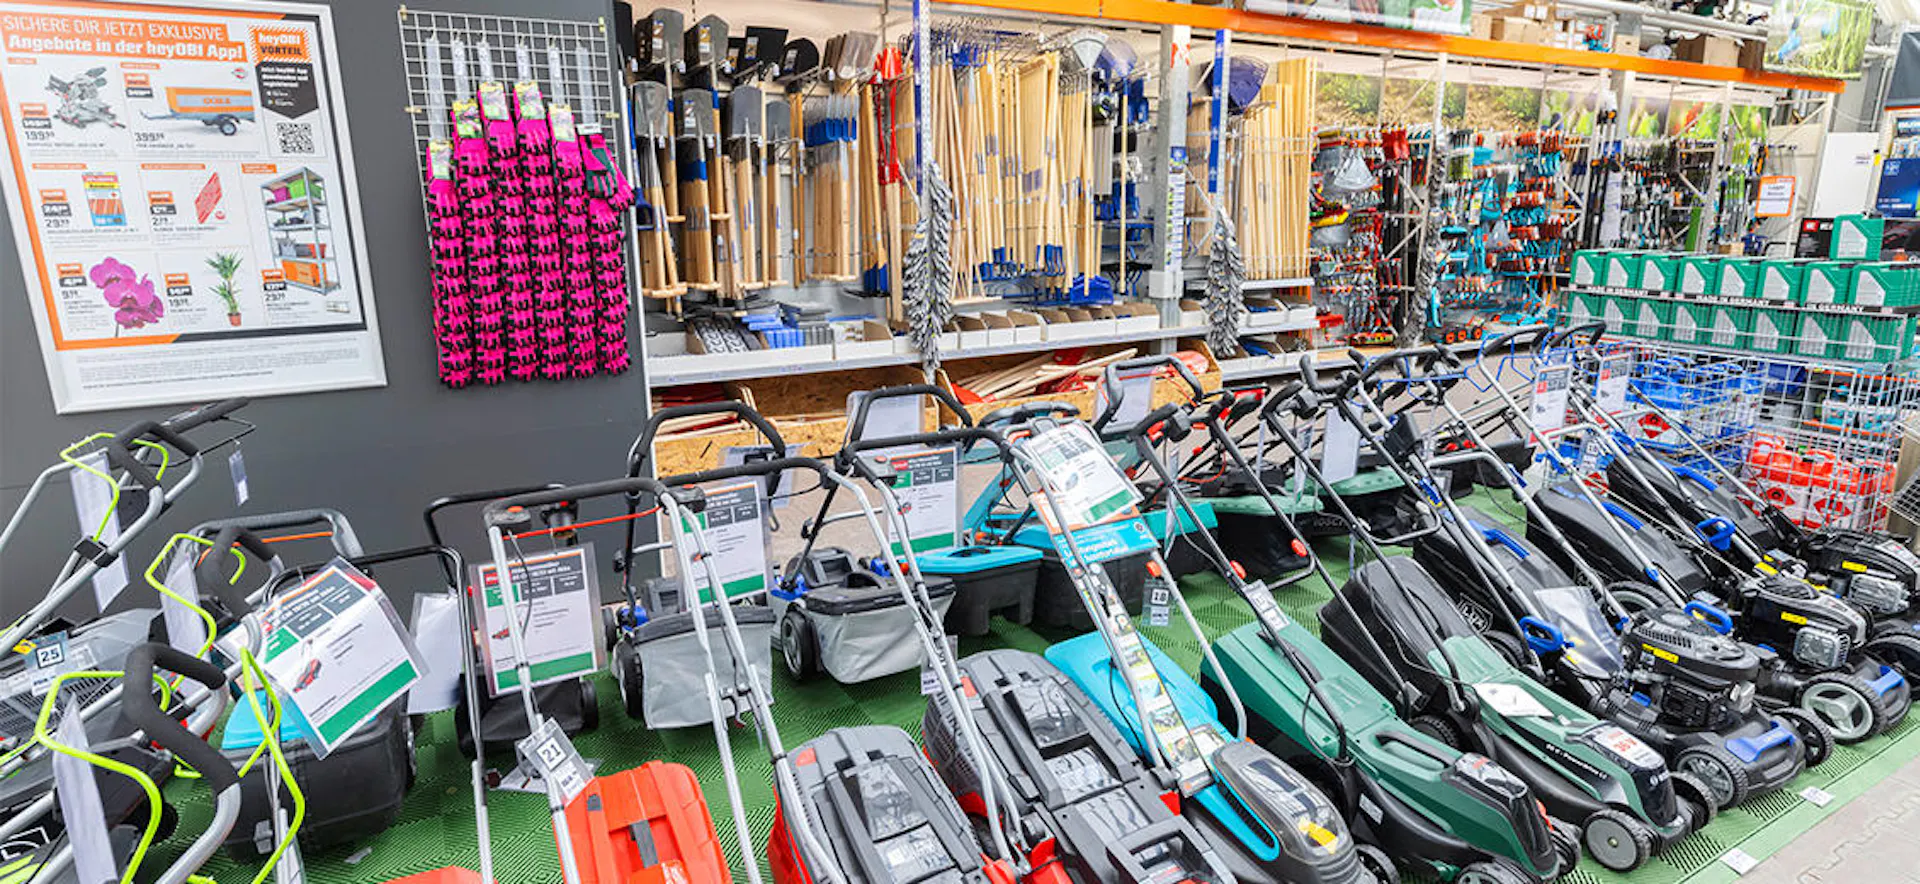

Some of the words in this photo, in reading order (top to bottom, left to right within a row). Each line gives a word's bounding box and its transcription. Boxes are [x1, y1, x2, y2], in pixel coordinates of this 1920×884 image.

[3, 15, 70, 33] SICHERE
[73, 19, 100, 34] DIR
[104, 21, 143, 37] JETZT
[149, 23, 224, 41] EXKLUSIVE
[9, 34, 92, 52] Angebote
[95, 38, 111, 52] in
[115, 39, 143, 54] der
[146, 41, 203, 58] heyOBI
[206, 44, 242, 60] App!
[258, 32, 300, 46] heyOBI
[261, 46, 302, 55] VORTEIL
[41, 648, 60, 662] 25
[542, 744, 561, 762] 21
